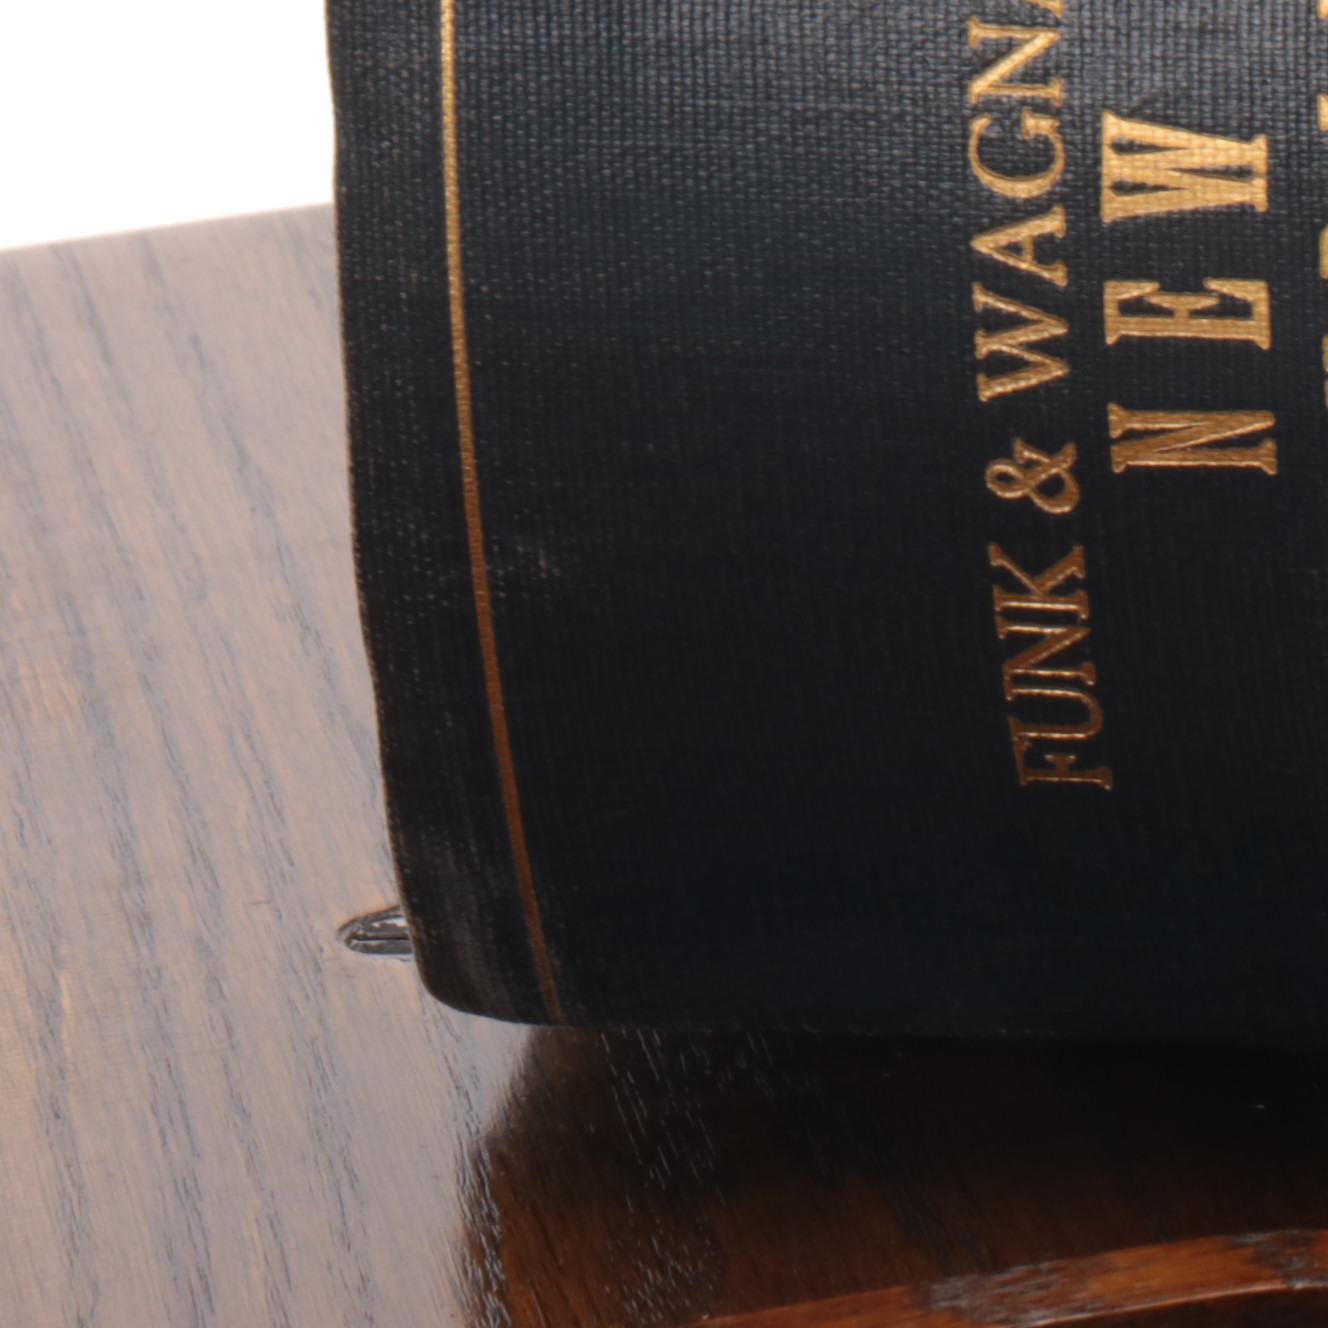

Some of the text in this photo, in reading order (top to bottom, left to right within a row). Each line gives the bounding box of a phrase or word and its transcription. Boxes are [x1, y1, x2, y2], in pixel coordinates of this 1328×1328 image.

[1100, 109, 1278, 477] NEW
[985, 439, 1081, 517] &
[989, 544, 1113, 789] FUNK
